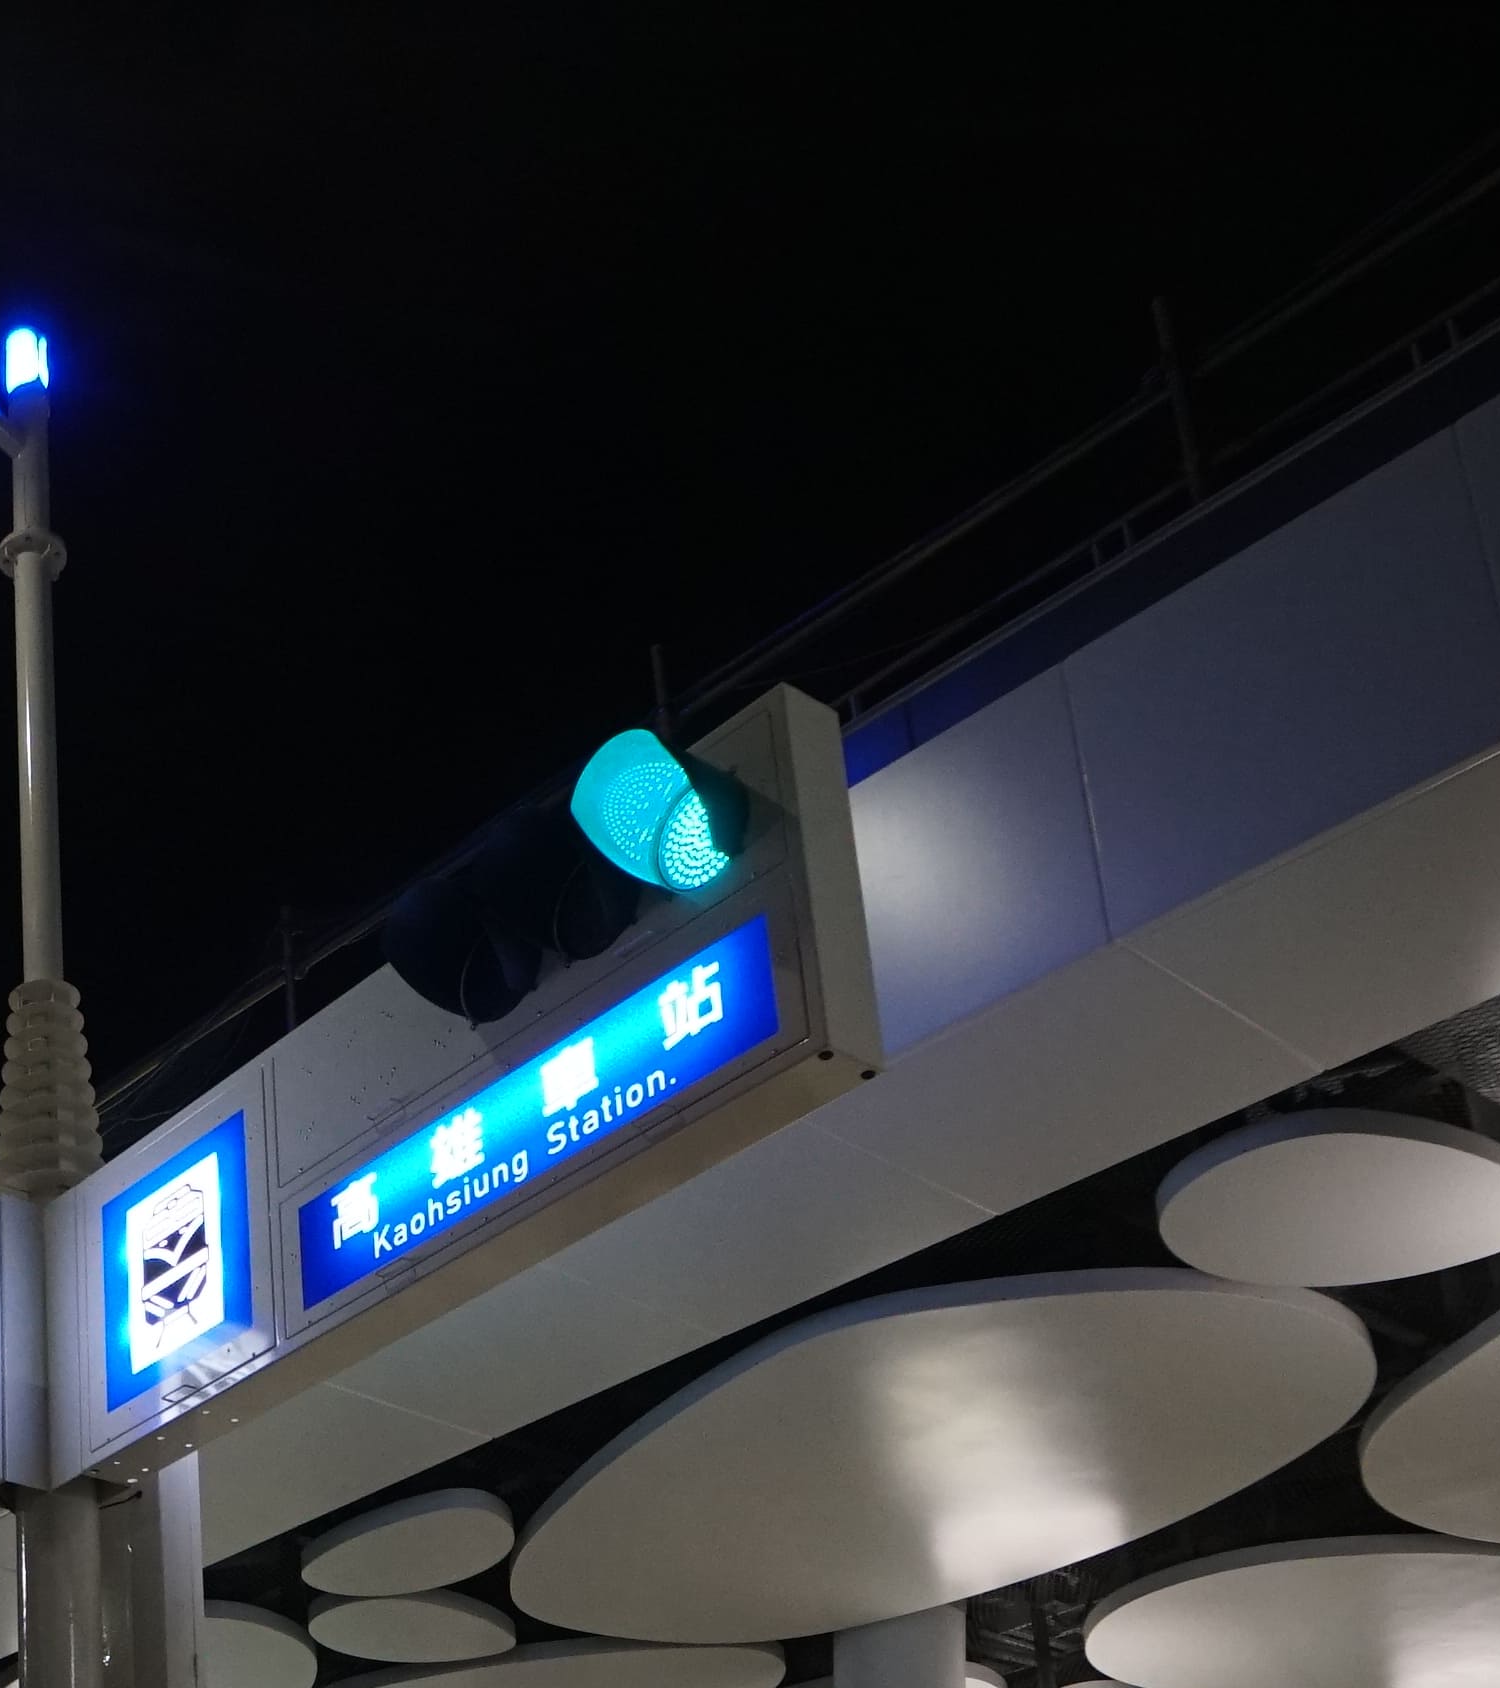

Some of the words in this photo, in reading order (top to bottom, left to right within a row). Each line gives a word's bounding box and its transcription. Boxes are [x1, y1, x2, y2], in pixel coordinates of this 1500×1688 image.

[331, 961, 724, 1249] 高雄車站
[373, 1150, 529, 1258] Kaohsiung
[546, 1069, 677, 1155] Station.
